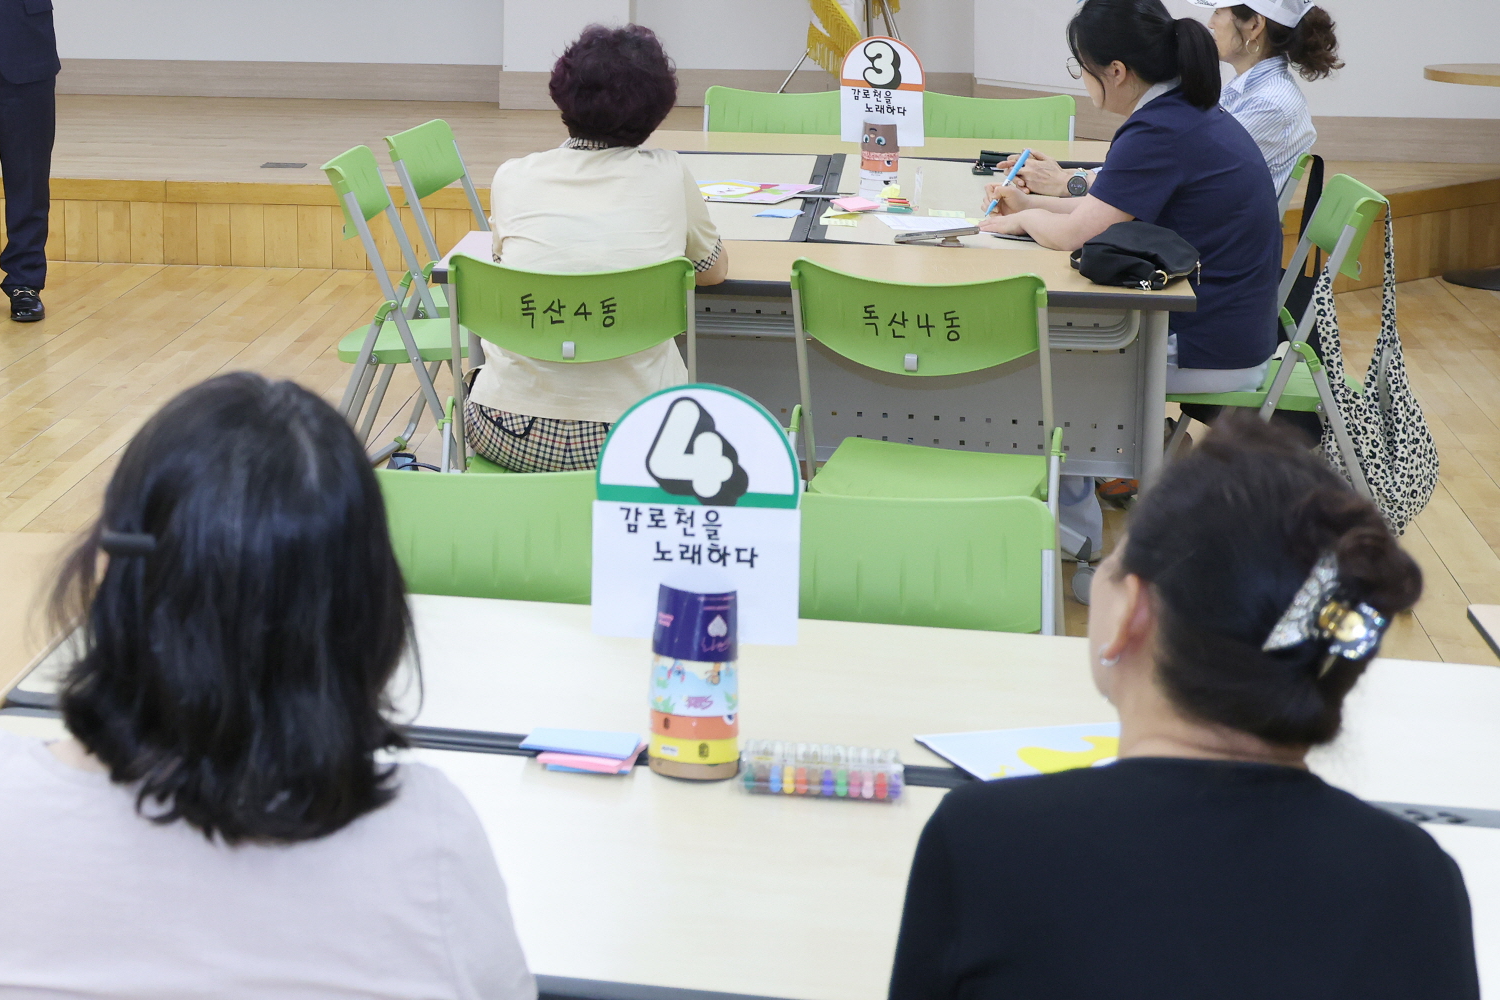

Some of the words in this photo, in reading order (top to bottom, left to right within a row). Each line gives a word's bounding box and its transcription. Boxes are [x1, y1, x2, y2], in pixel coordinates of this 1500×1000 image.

[863, 40, 902, 89] 3
[851, 88, 893, 104] 감로천을
[864, 103, 907, 117] 노래하다
[645, 396, 749, 506] 4
[619, 505, 723, 542] 감로천을
[653, 541, 759, 569] 노래하다
